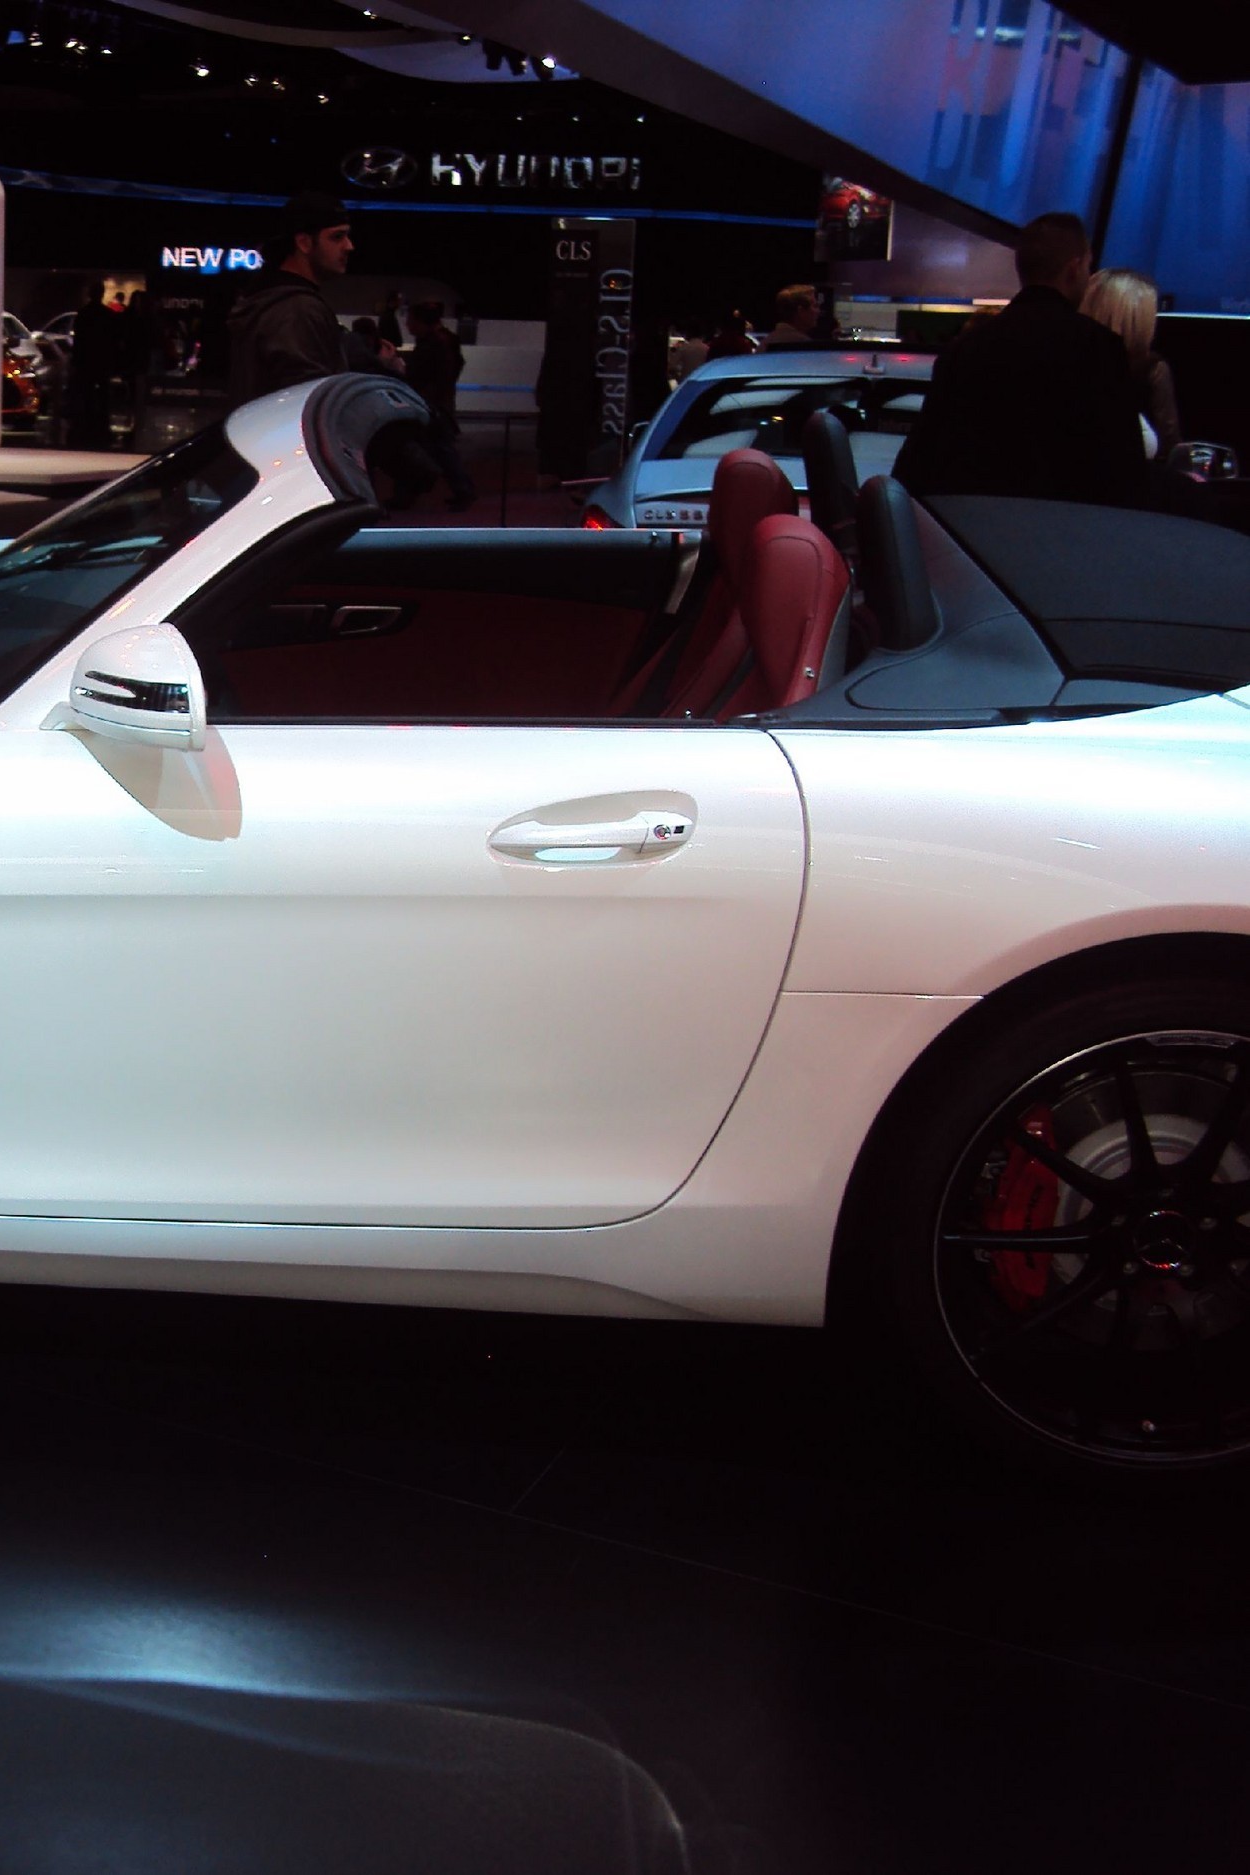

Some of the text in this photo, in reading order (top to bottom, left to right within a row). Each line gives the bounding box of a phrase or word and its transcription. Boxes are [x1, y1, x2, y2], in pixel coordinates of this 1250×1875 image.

[430, 153, 640, 190] HYUNDAI
[162, 247, 224, 268] NEW
[555, 240, 592, 261] CLS
